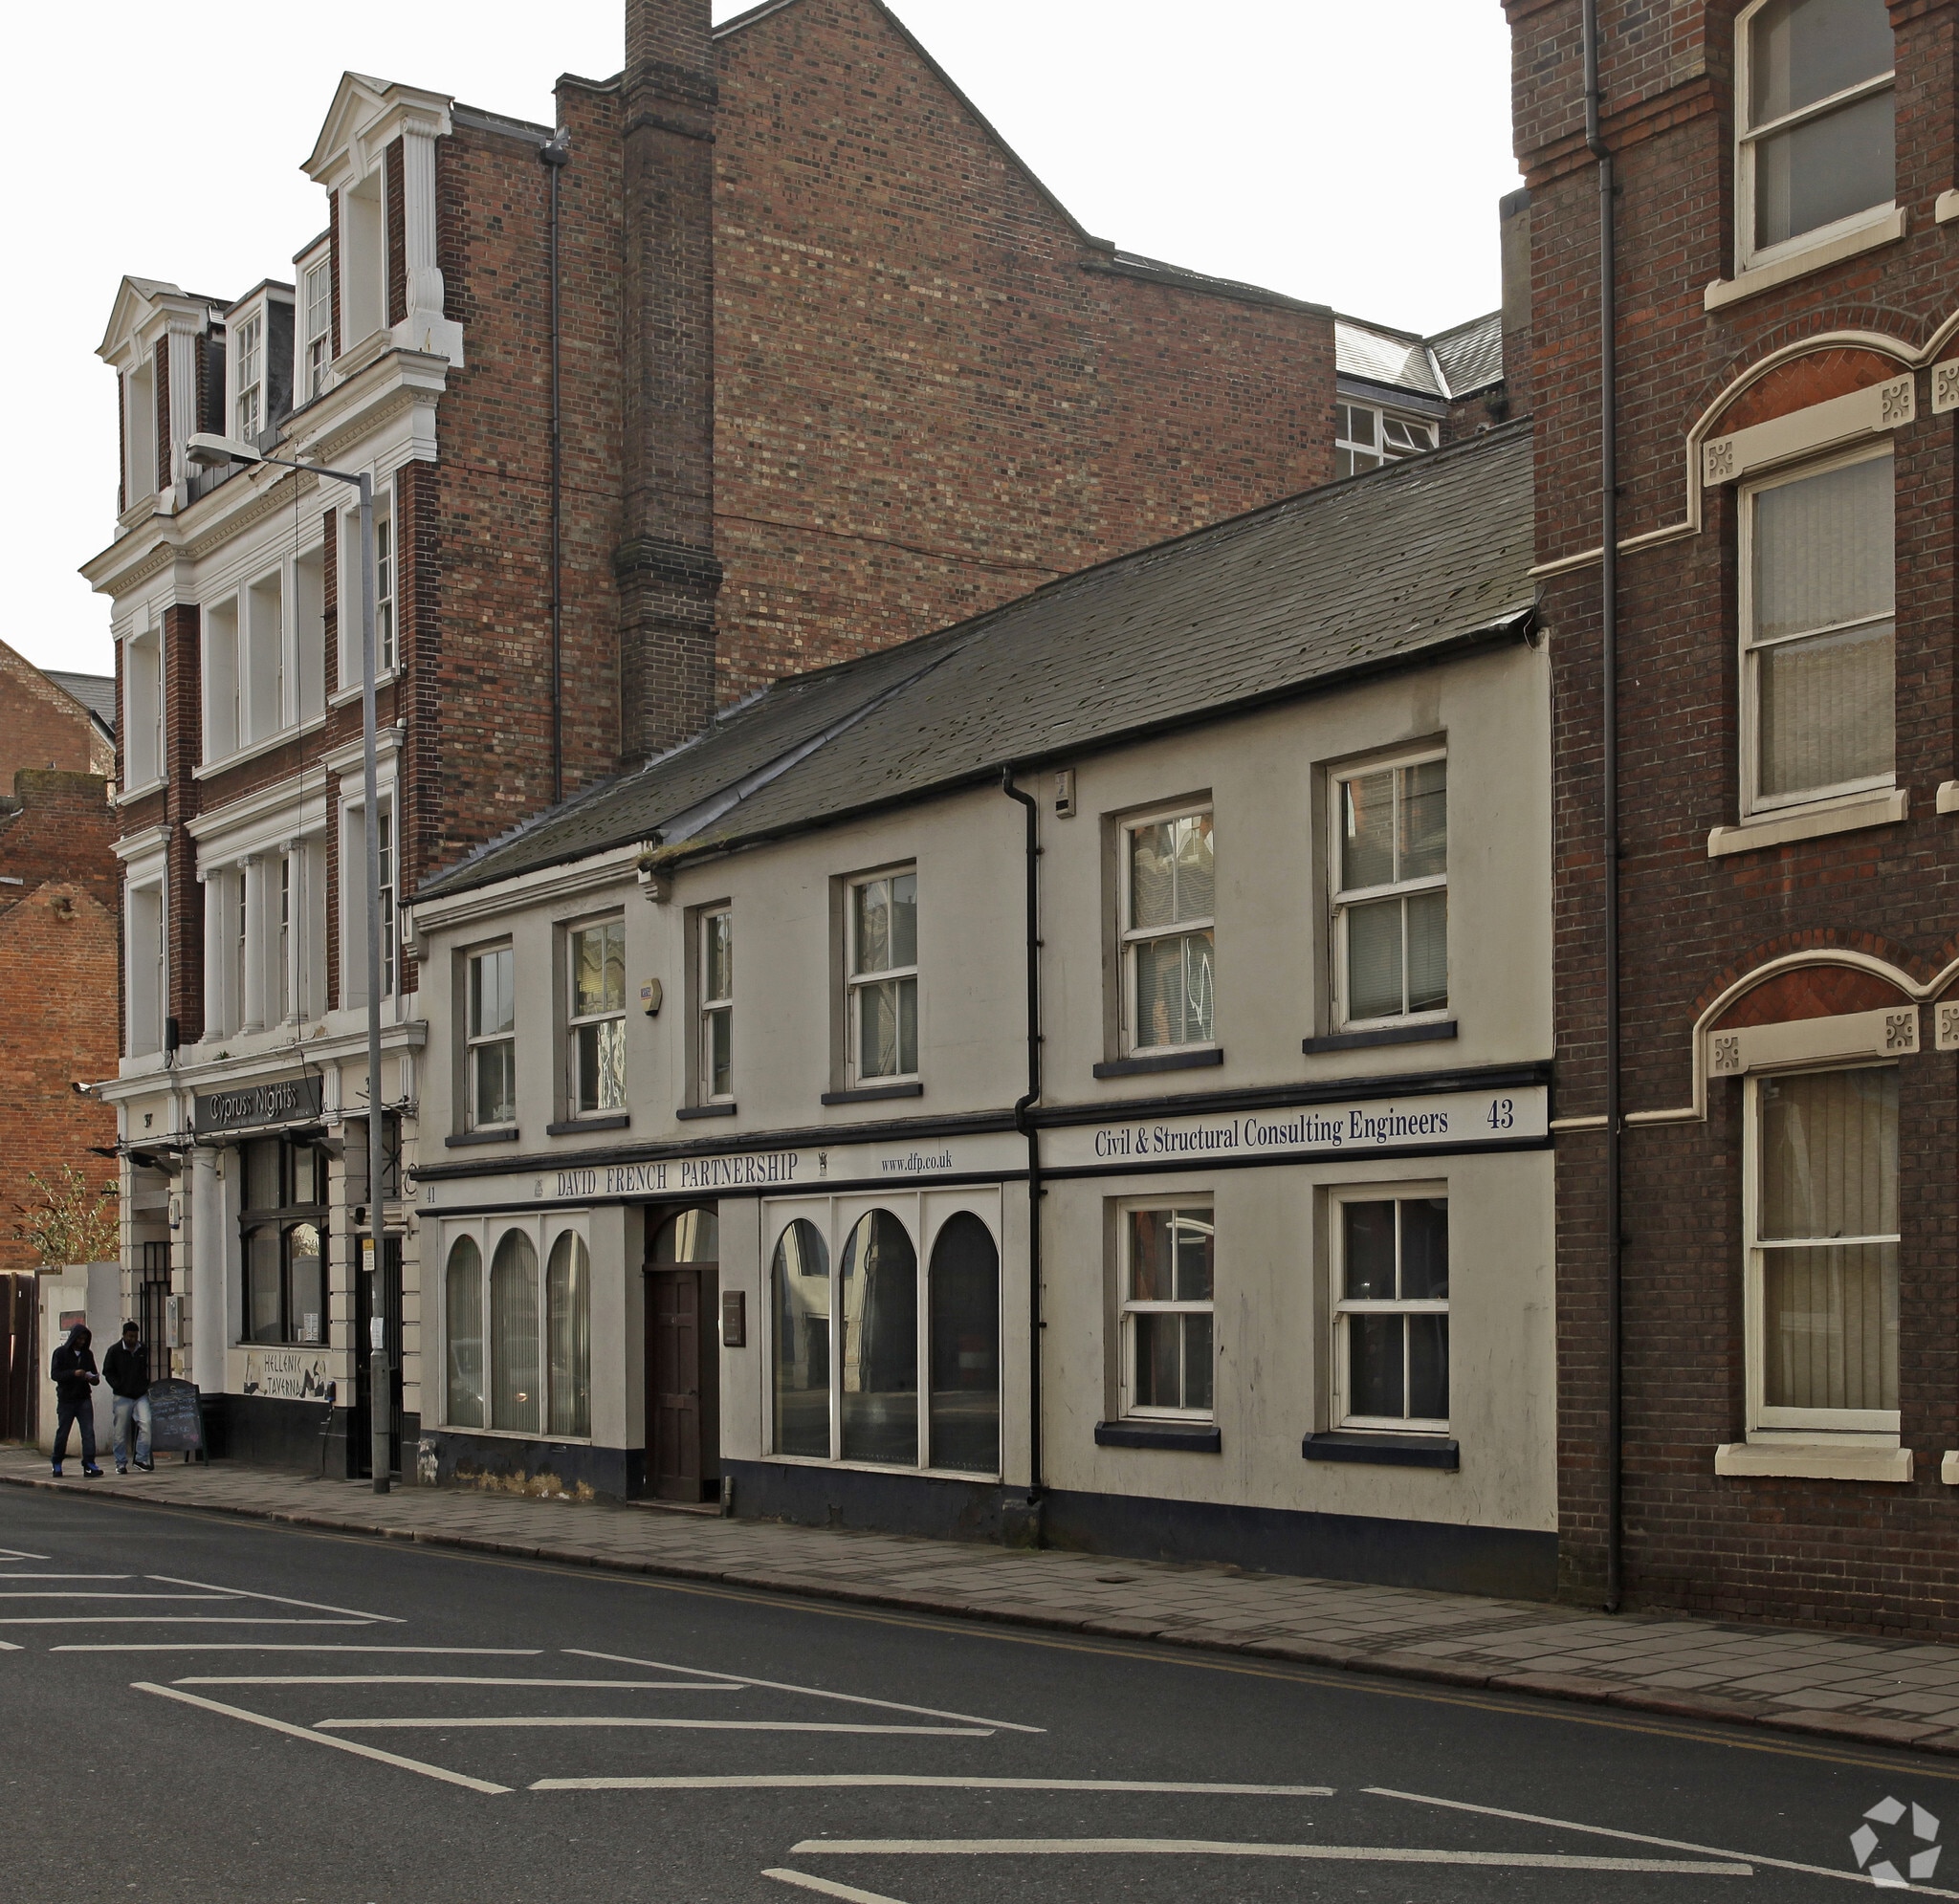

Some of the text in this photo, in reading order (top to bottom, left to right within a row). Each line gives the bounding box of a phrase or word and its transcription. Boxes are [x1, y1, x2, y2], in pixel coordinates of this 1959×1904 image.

[210, 1083, 297, 1125] Cyprus Nights
[1486, 1099, 1514, 1129] 43
[1095, 1107, 1448, 1157] Civil & Structural Consulting Engineers
[558, 1152, 799, 1196] DAVID FRENCH PARTNERSHIP
[881, 1149, 953, 1174] www.dfp.co.uk
[264, 1353, 302, 1374] HELLENIC
[267, 1376, 300, 1397] TAVERNA
